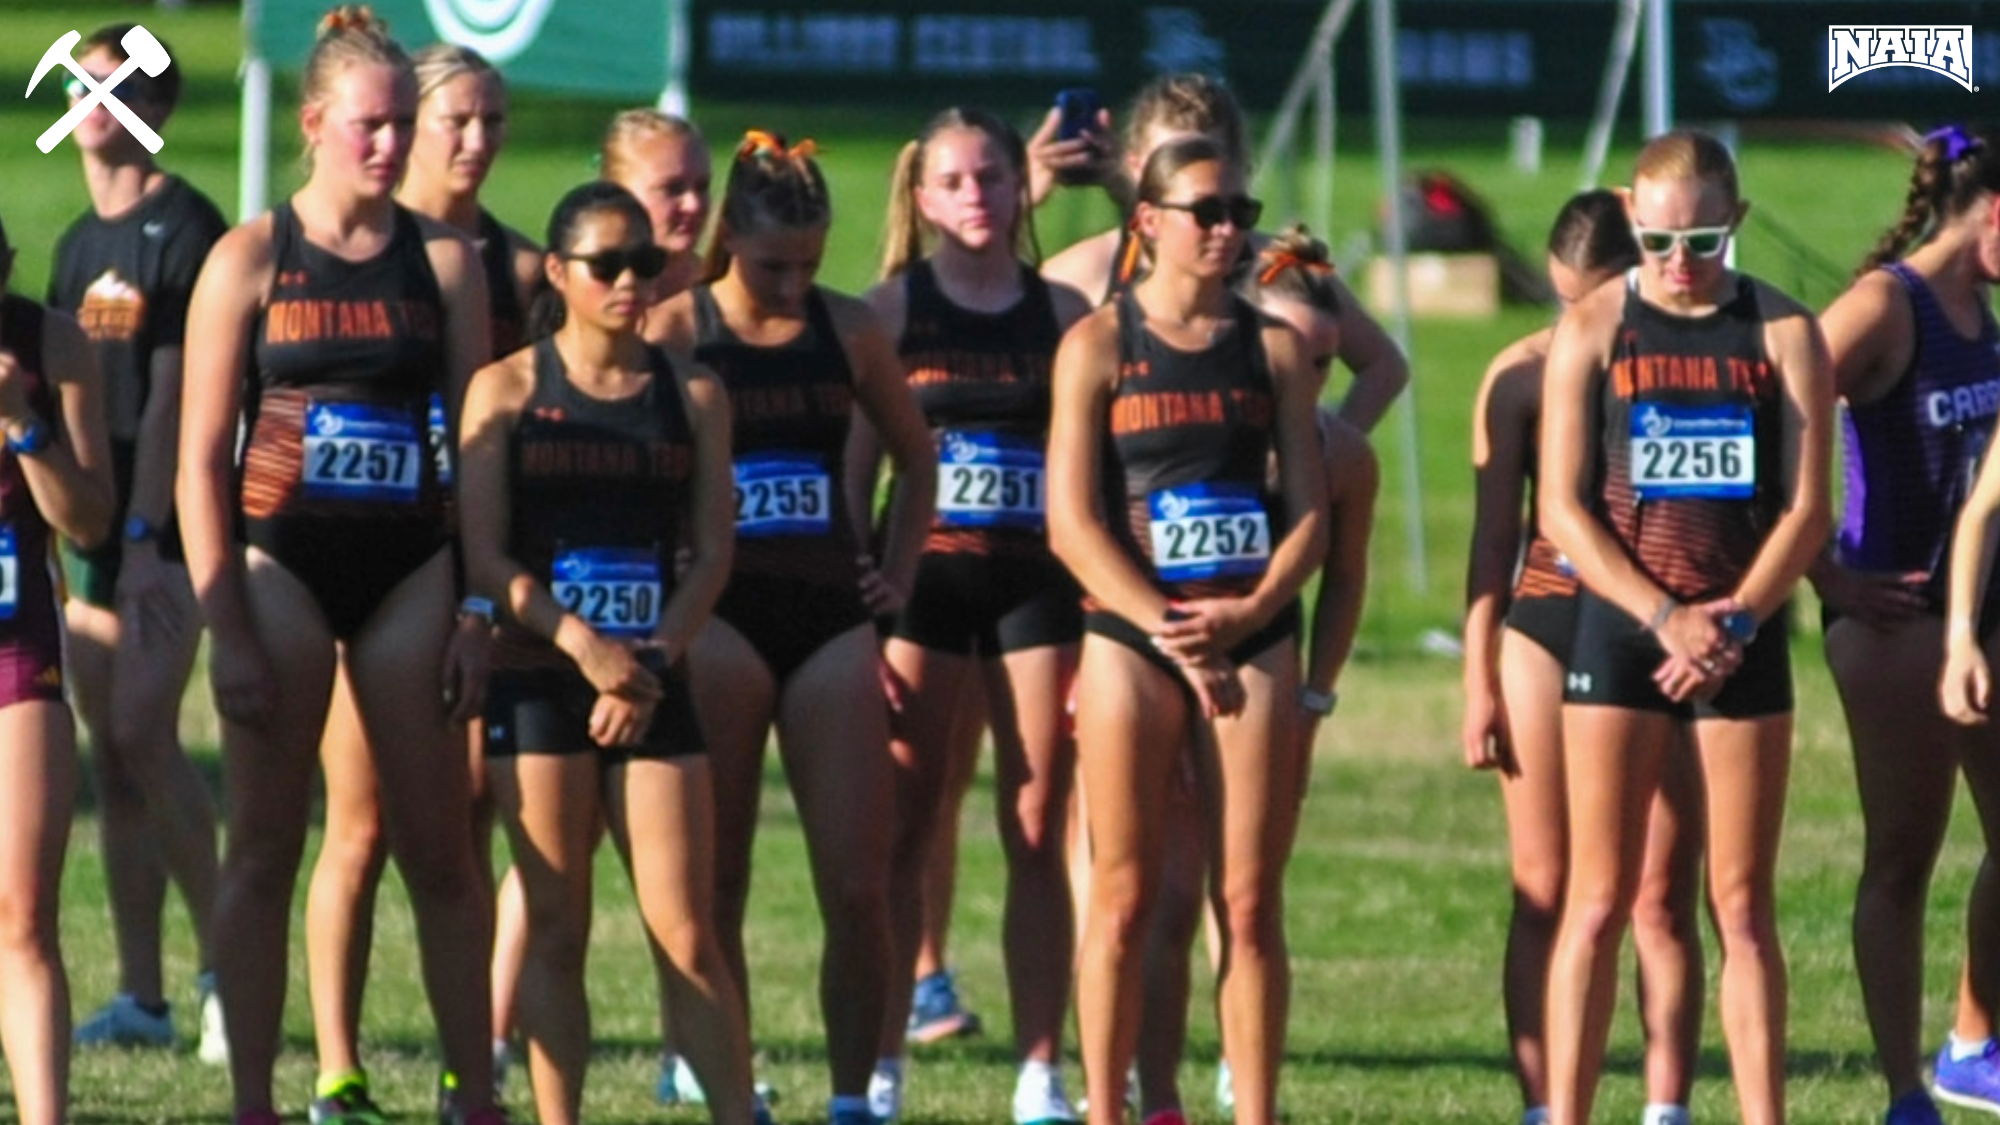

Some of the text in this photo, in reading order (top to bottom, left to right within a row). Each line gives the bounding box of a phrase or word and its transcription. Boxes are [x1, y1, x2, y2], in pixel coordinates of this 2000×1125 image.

[265, 299, 394, 344] MONTANA
[1612, 354, 1719, 399] MNTANA
[1109, 389, 1225, 437] MONTANA
[316, 440, 408, 483] 2257
[1642, 441, 1742, 479] 2256
[734, 479, 820, 520] 2255
[953, 466, 1036, 508] 2251
[1165, 517, 1260, 560] 2252
[563, 585, 652, 624] 2250
